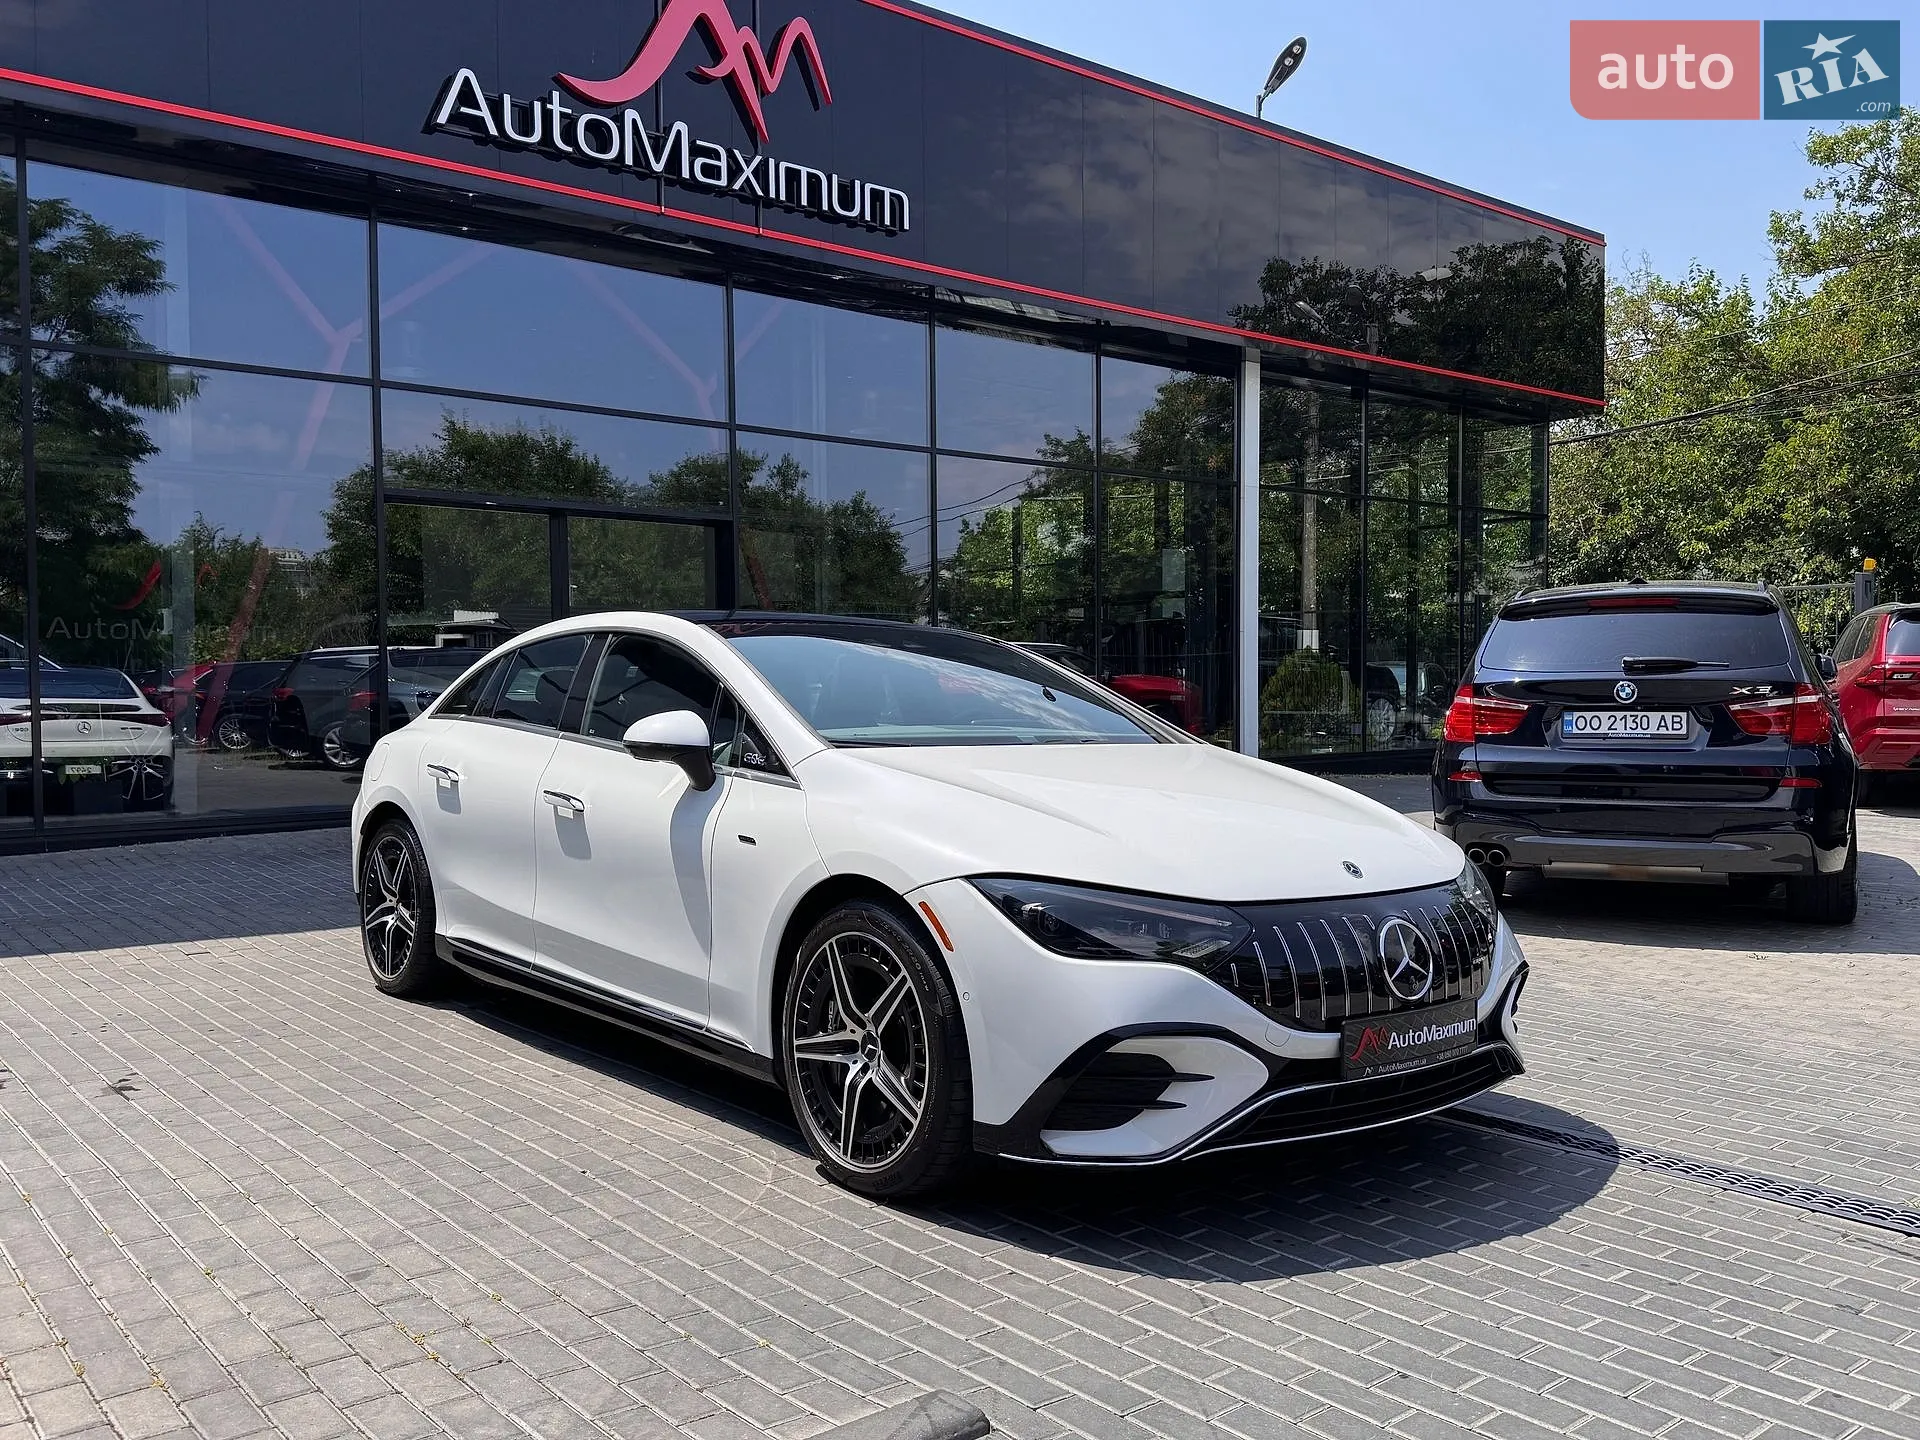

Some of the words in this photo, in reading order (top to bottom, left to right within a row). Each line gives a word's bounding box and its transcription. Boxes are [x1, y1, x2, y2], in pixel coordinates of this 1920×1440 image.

[434, 67, 911, 232] AutoMaximum
[1728, 685, 1773, 695] X3
[1606, 713, 1651, 732] 2130
[1657, 714, 1684, 732] AB
[1387, 1018, 1477, 1050] AutoMaximum
